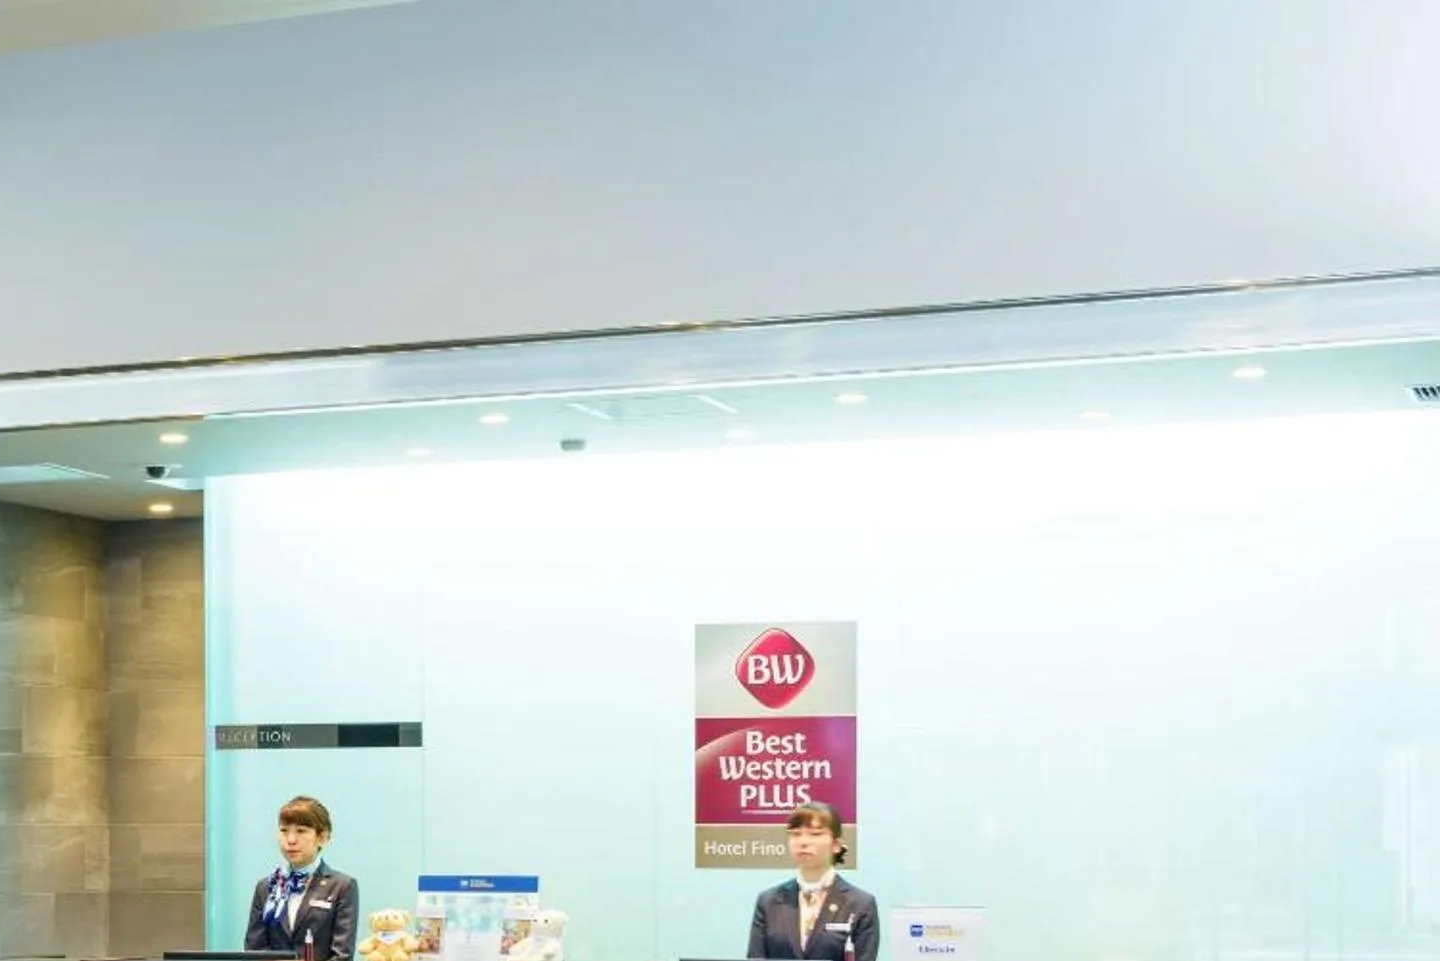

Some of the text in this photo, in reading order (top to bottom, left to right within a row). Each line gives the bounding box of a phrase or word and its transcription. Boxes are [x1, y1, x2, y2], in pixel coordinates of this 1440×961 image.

[747, 654, 806, 685] BW
[745, 730, 807, 754] Best
[718, 755, 832, 781] Western
[740, 784, 812, 808] PLUS
[703, 840, 787, 856] Hotel Fino
